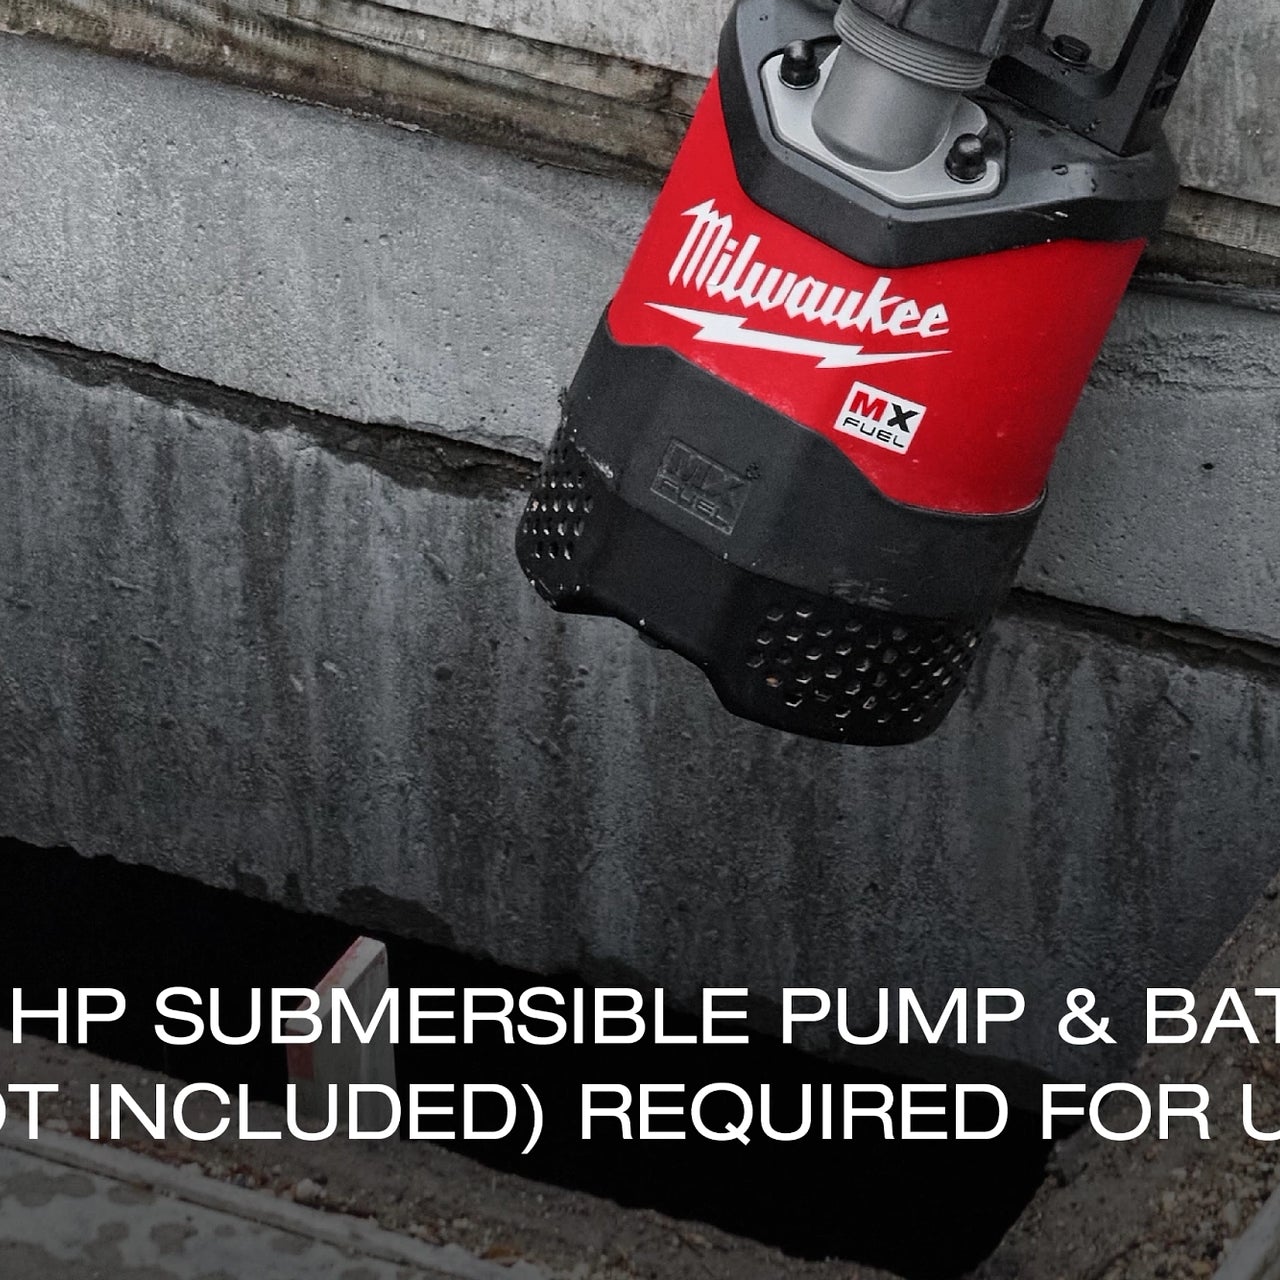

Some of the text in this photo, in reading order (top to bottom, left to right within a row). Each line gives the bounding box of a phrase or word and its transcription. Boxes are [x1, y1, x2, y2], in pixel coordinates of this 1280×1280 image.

[668, 198, 950, 338] Milwaukee
[842, 416, 905, 449] FUEL
[848, 390, 921, 434] MX
